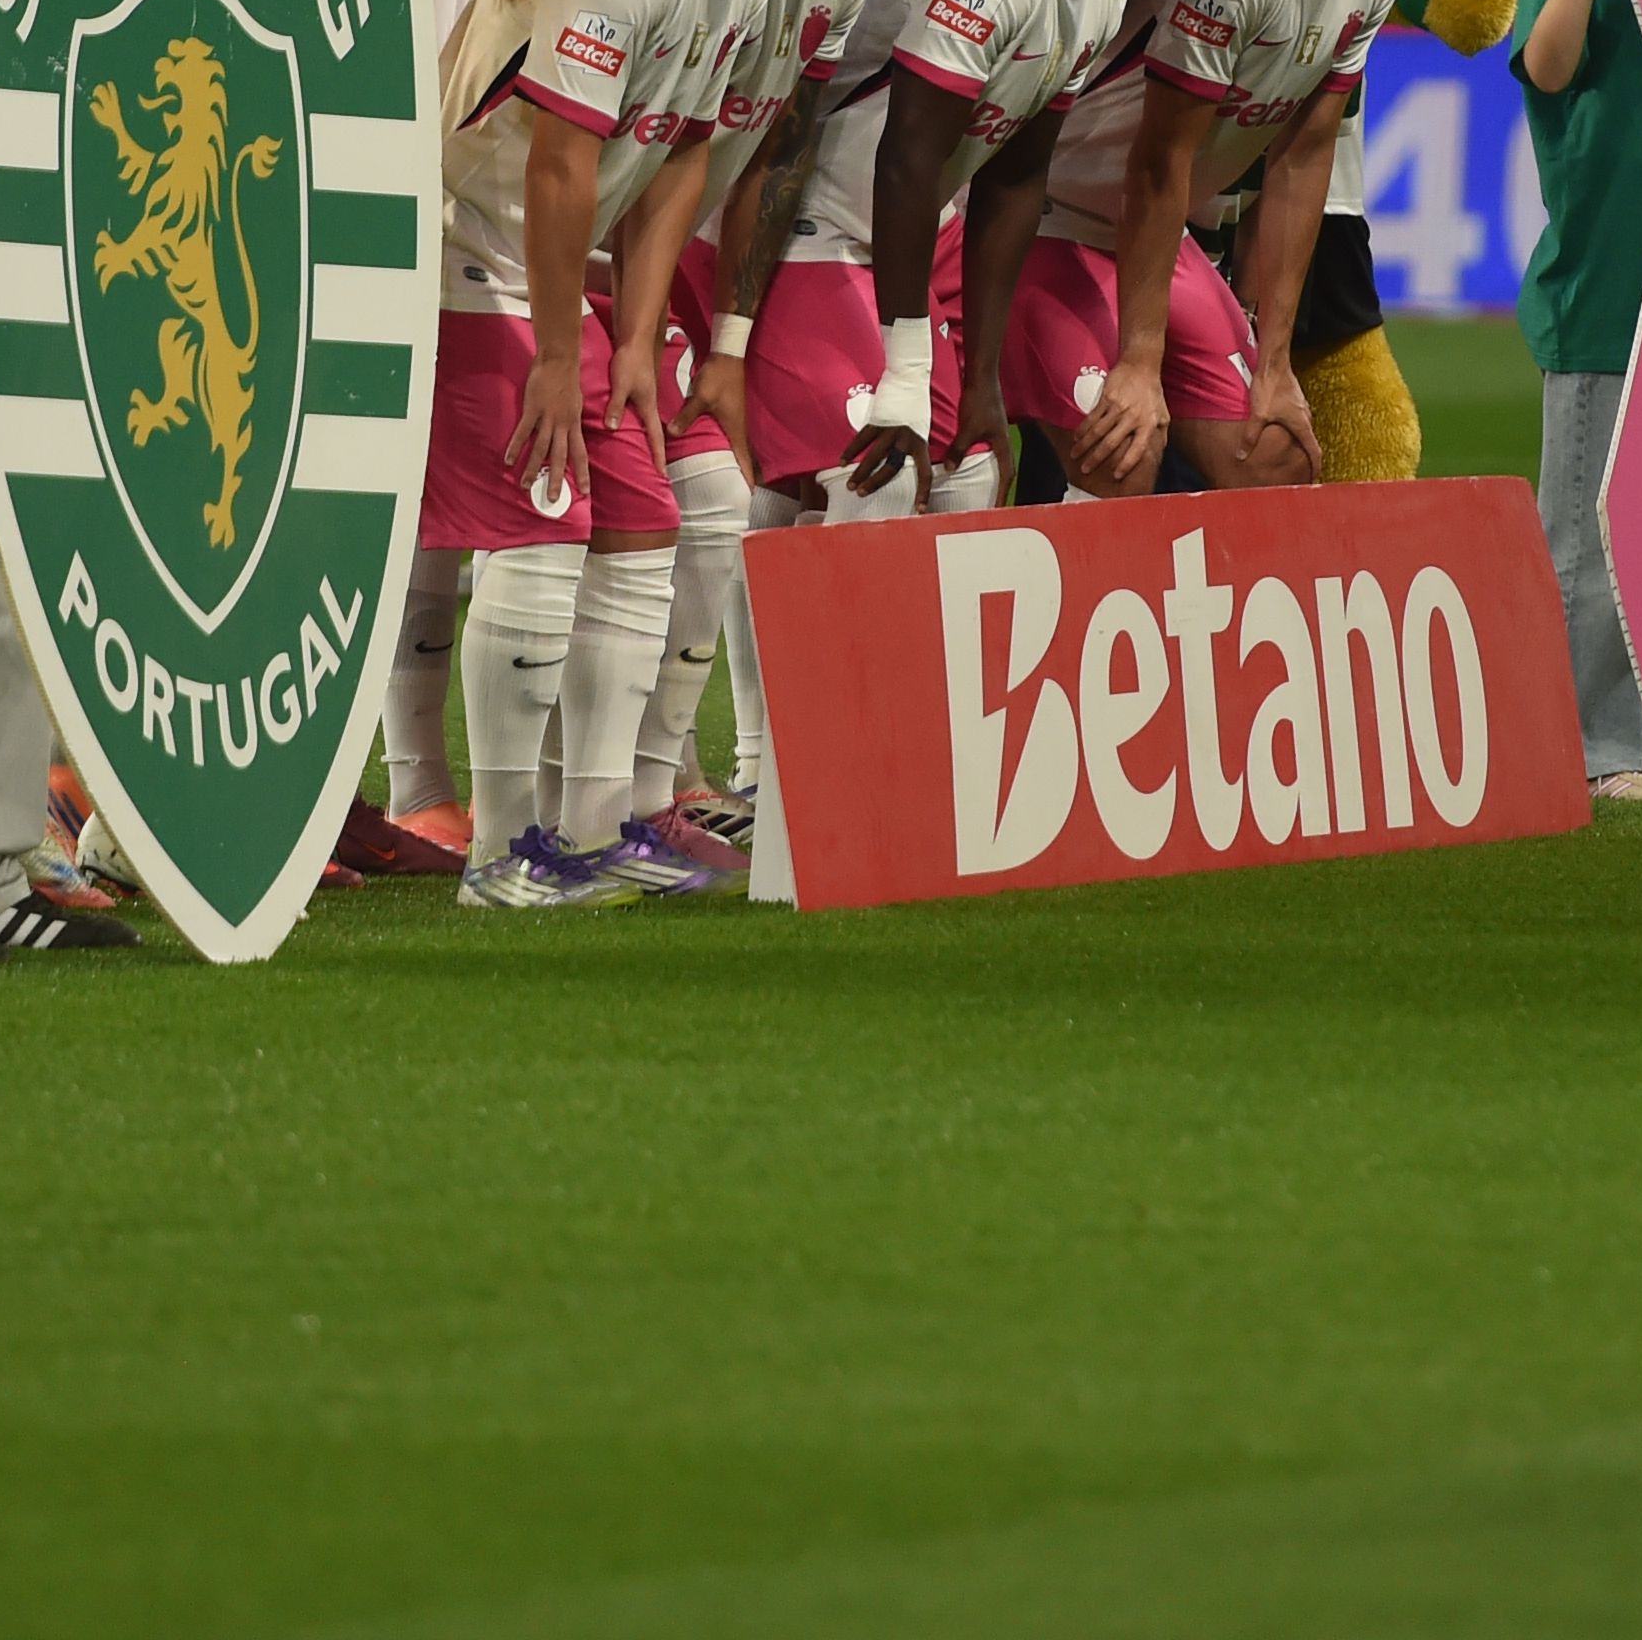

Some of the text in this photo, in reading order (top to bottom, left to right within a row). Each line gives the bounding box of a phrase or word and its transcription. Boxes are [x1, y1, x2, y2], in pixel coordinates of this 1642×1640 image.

[931, 0, 987, 39] Betclic
[1175, 8, 1229, 42] Betclic
[561, 34, 619, 70] Betclic
[57, 550, 364, 768] PORTUGAL
[935, 526, 1489, 877] Betano
